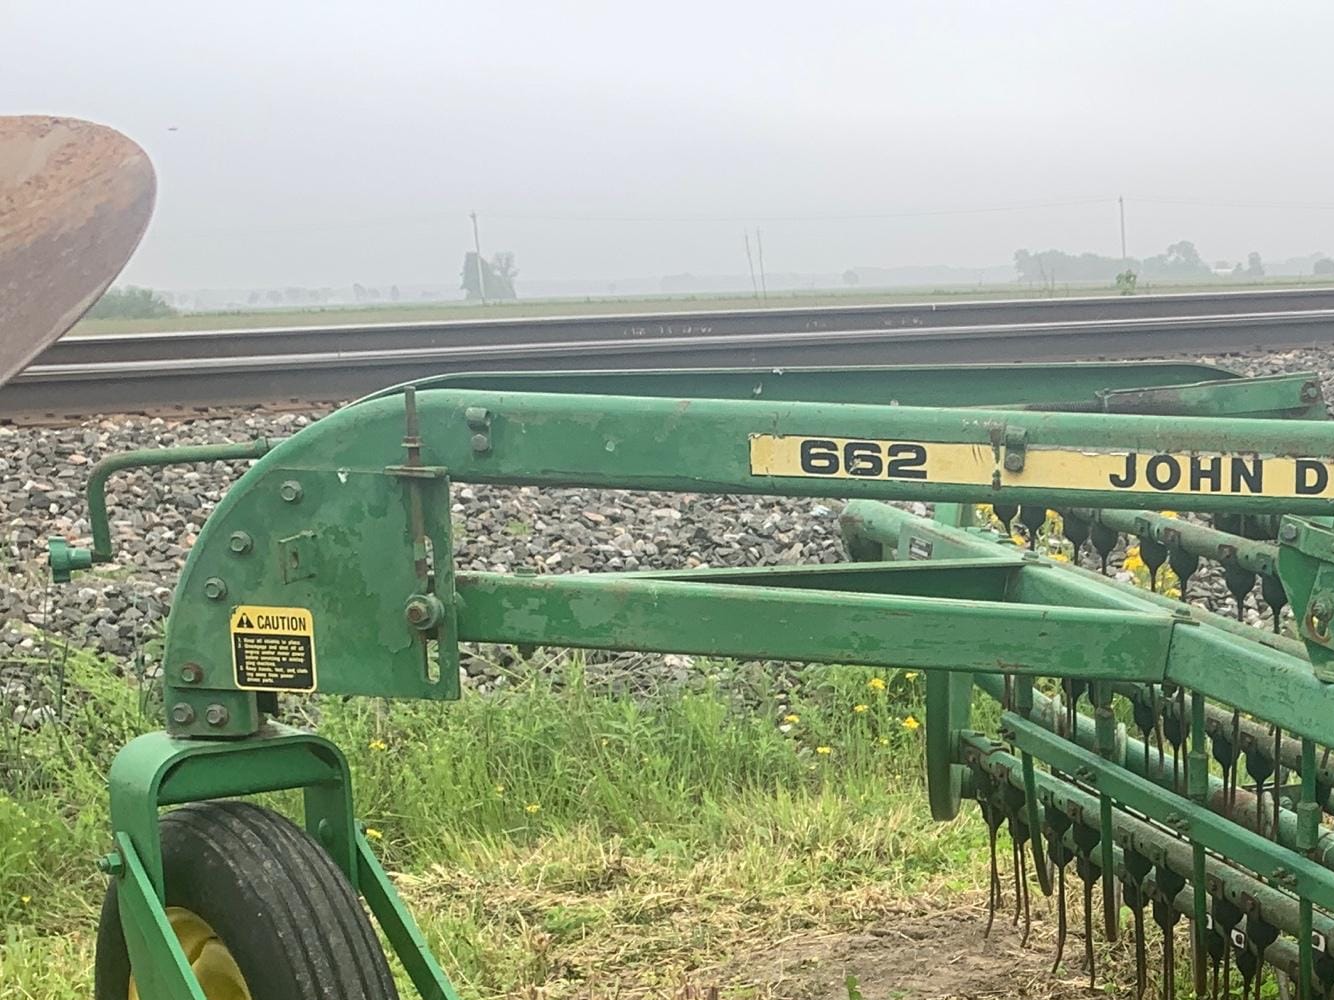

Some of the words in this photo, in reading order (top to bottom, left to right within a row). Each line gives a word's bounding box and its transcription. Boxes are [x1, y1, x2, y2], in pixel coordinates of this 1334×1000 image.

[800, 439, 928, 480] 662
[1109, 453, 1263, 493] JOHN
[257, 615, 306, 631] CAUTION
